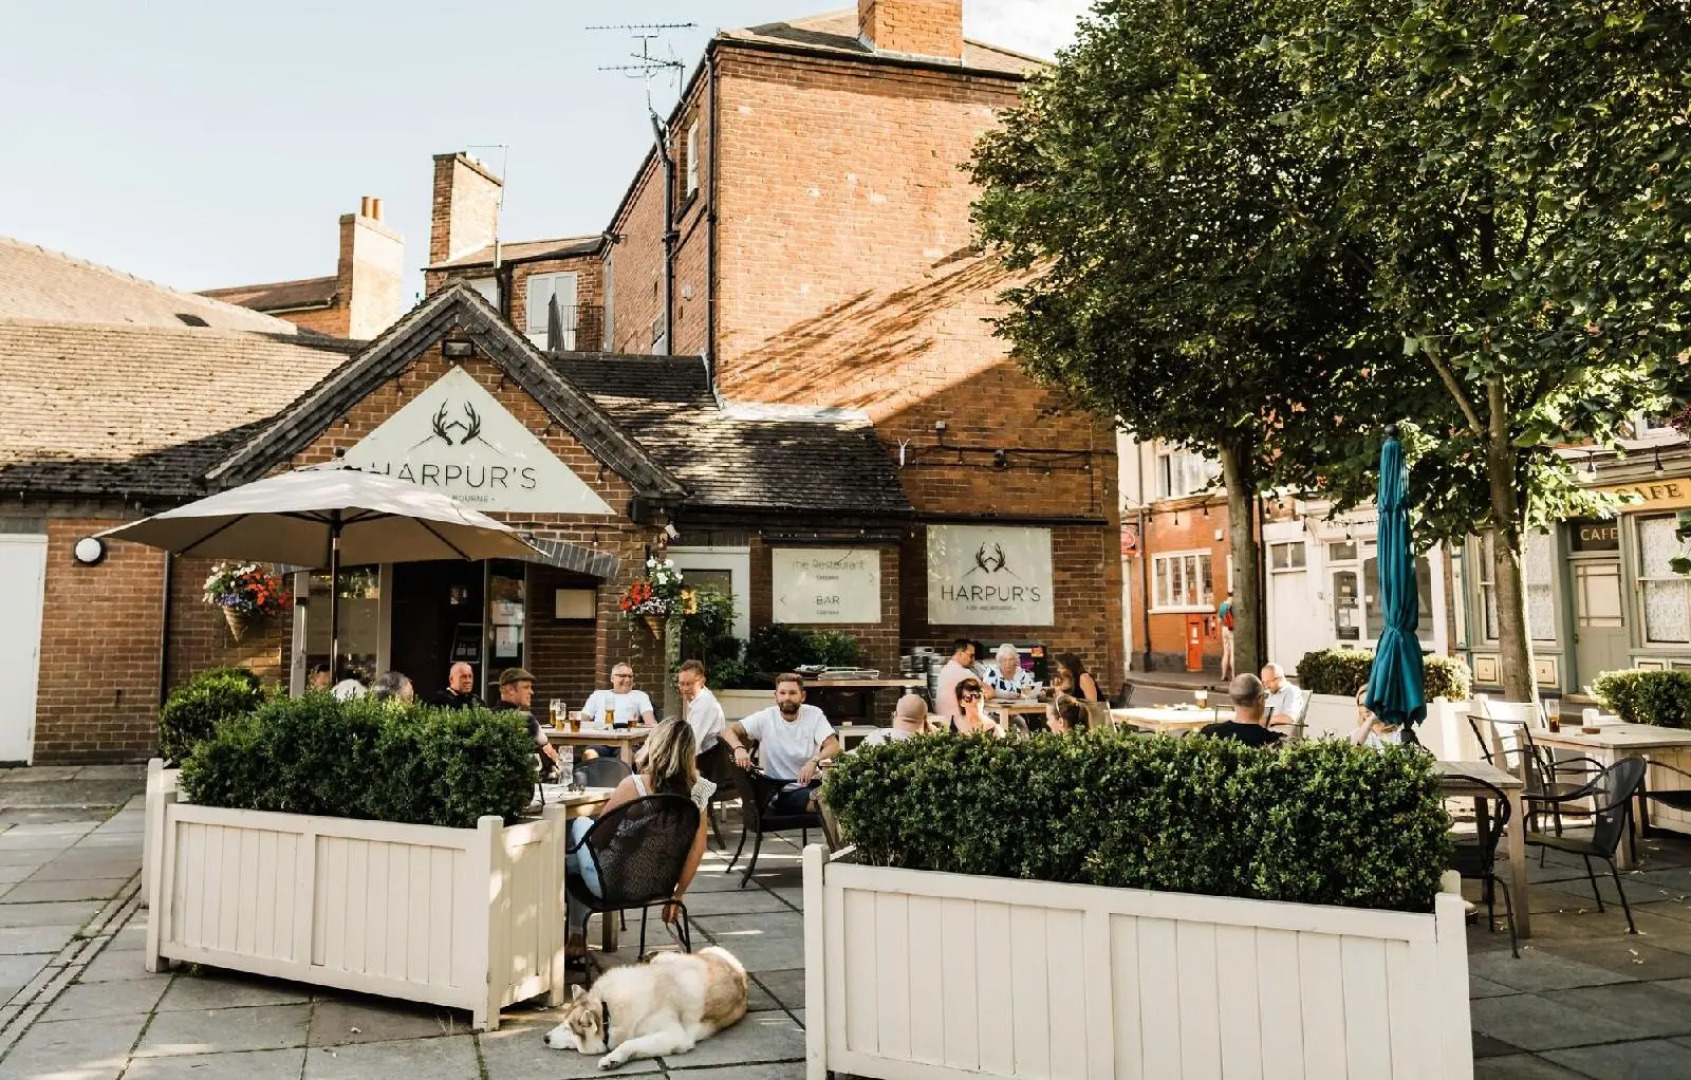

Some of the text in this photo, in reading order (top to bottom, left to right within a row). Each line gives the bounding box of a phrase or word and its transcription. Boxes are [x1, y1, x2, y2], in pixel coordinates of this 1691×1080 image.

[452, 494, 489, 502] BOURNE
[1580, 527, 1618, 541] CAFE
[941, 585, 1041, 602] HARPUR'S
[816, 595, 840, 605] BAR
